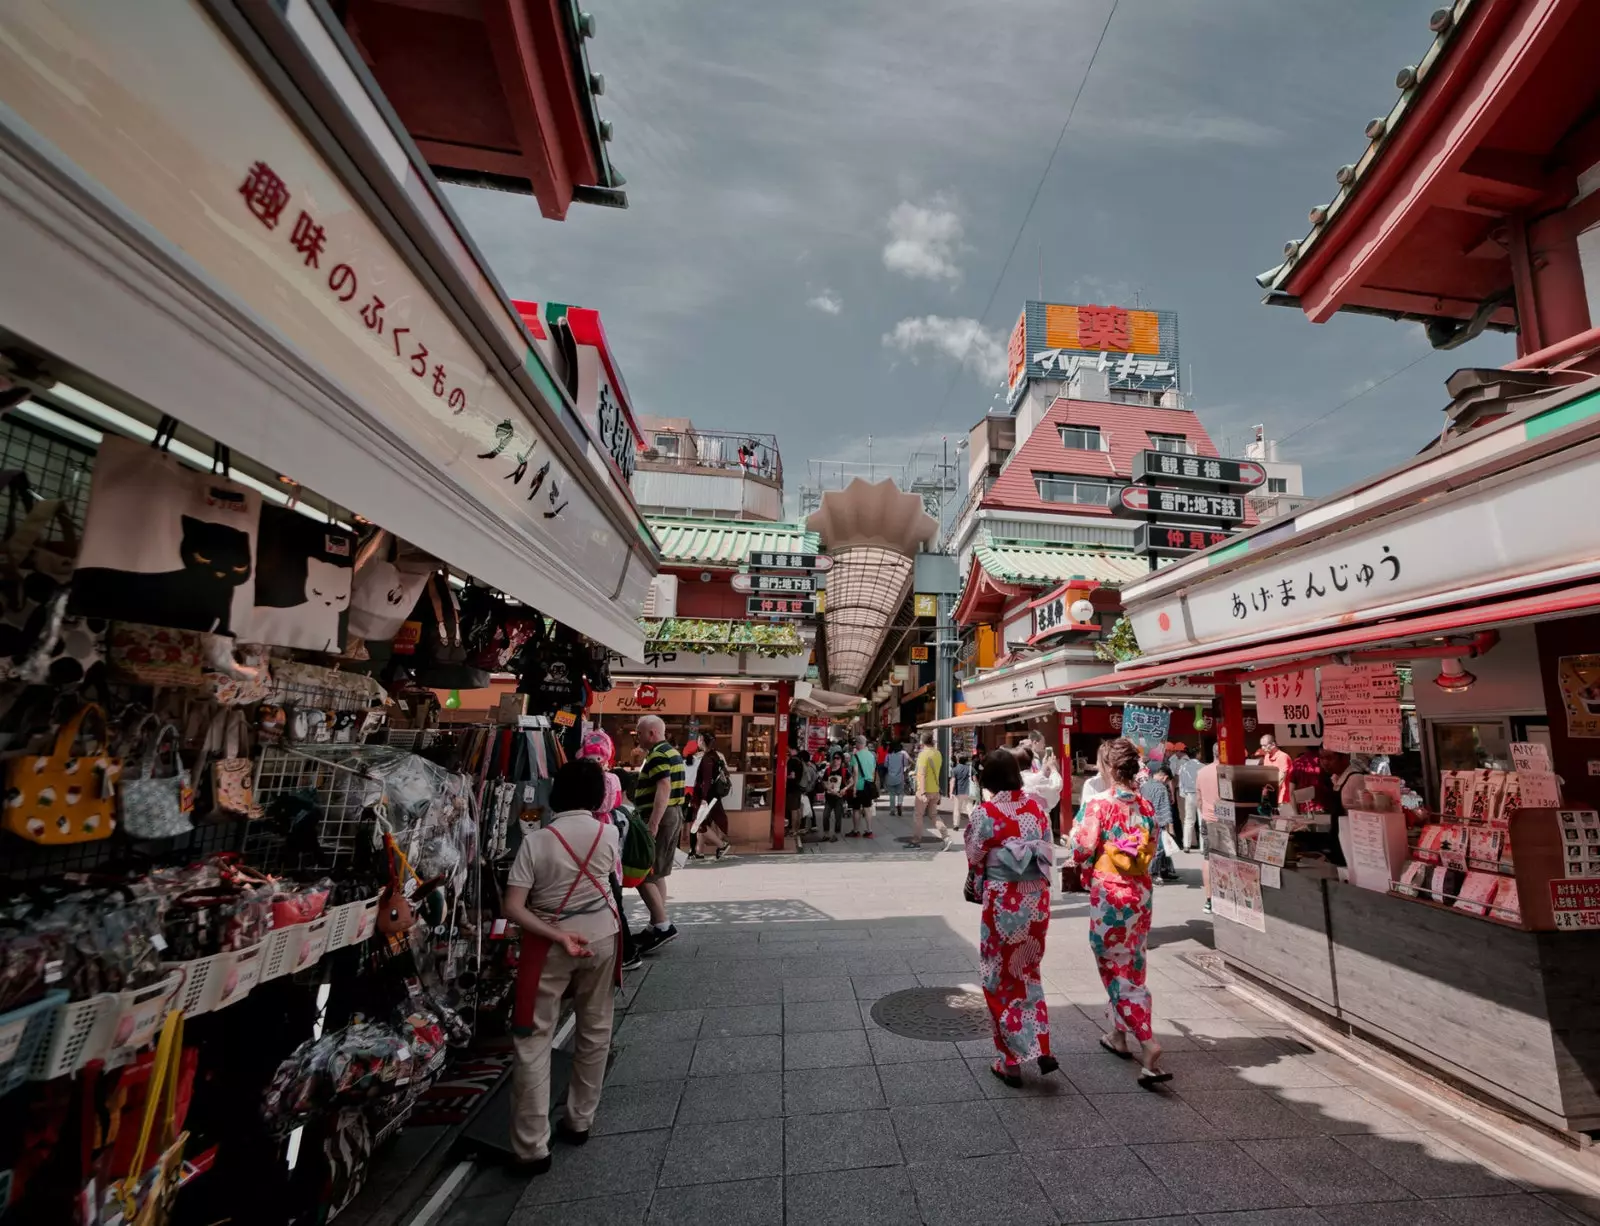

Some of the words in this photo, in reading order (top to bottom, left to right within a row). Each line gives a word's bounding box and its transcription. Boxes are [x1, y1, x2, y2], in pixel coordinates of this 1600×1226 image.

[237, 160, 466, 415] 趣味のふくろもの
[1077, 304, 1130, 350] 薬
[1160, 456, 1221, 479] 観音様
[761, 554, 802, 567] 観音様
[1231, 545, 1401, 620] あげまんじゅう
[761, 600, 803, 612] 仲見世
[1265, 681, 1302, 699] ドリンク
[1132, 711, 1161, 727] 電球
[1283, 704, 1310, 720] ¥350
[1513, 744, 1534, 756] ANY
